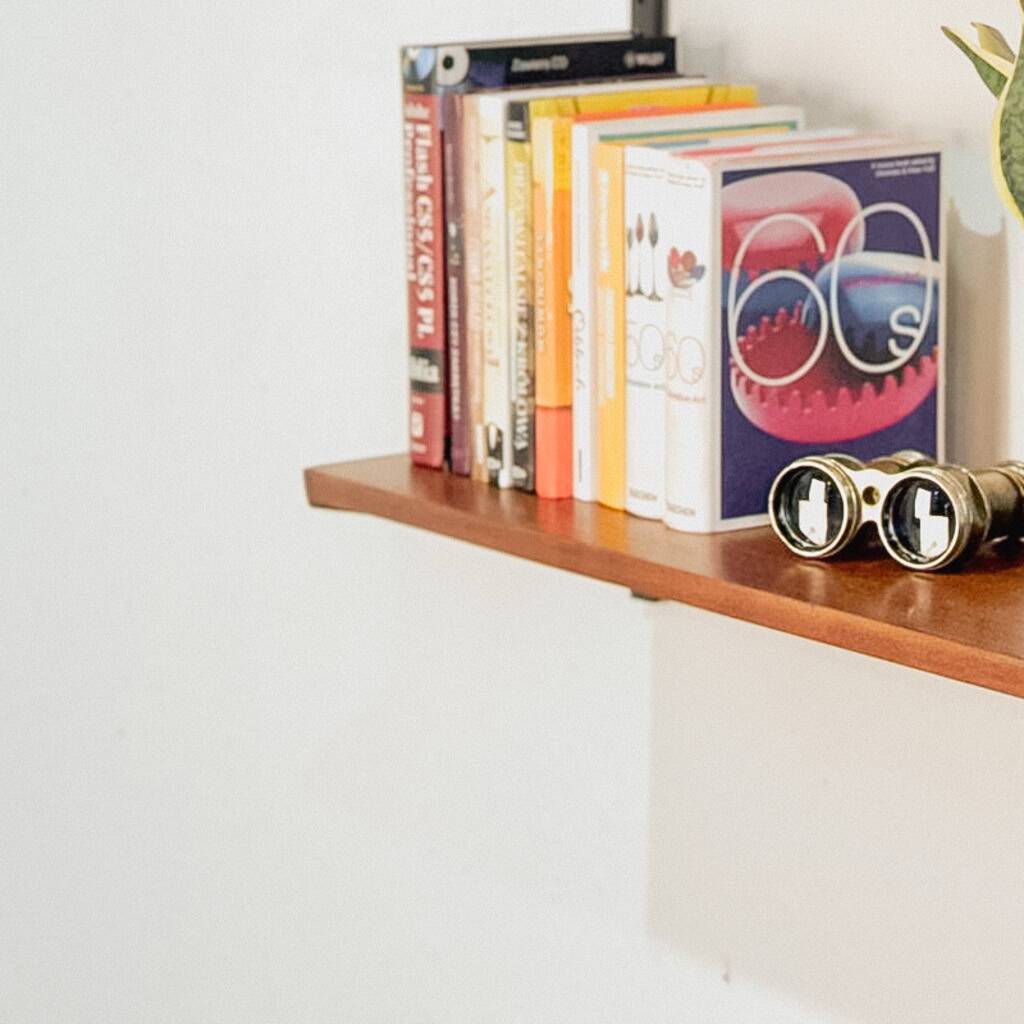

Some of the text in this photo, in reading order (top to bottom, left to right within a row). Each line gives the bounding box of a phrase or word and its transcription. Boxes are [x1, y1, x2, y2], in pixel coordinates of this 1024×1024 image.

[415, 124, 433, 192] Flash
[415, 194, 435, 302] CS5/CS5
[728, 201, 933, 387] 60s
